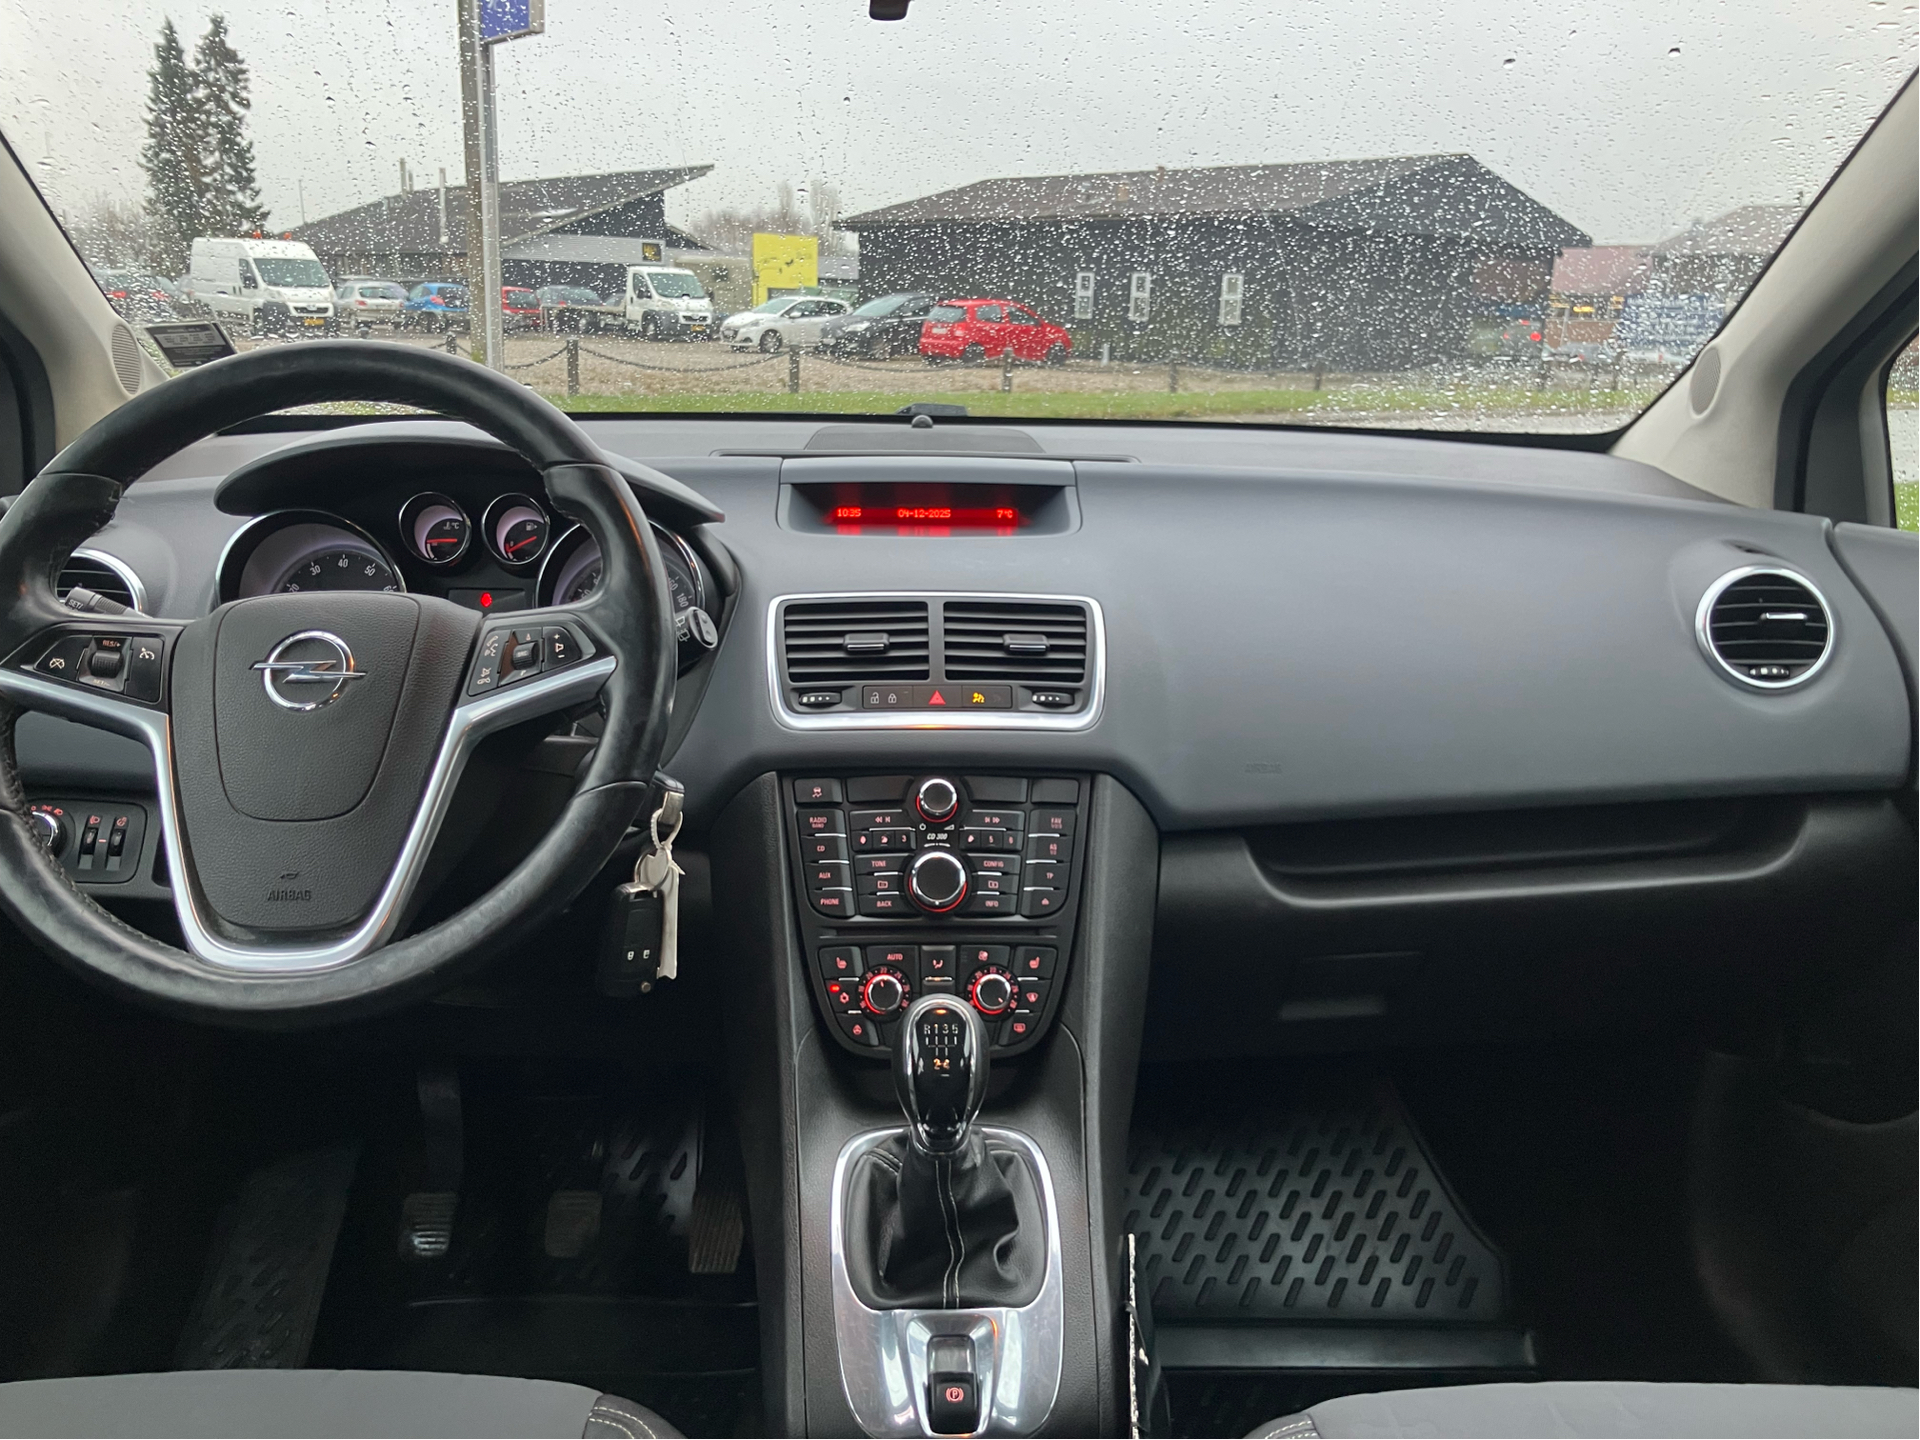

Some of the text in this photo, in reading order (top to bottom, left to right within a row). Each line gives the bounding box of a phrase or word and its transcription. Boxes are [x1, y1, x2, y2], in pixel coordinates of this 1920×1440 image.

[898, 508, 950, 518] 04-12-2025
[337, 559, 349, 568] 40
[309, 565, 321, 576] 30
[364, 566, 376, 577] 50
[676, 593, 689, 608] 180
[926, 832, 936, 840] CD
[983, 860, 1004, 868] CONFIG
[267, 890, 312, 901] AIRBAG
[886, 953, 904, 961] AUTO
[924, 1023, 958, 1035] R 1 3 5
